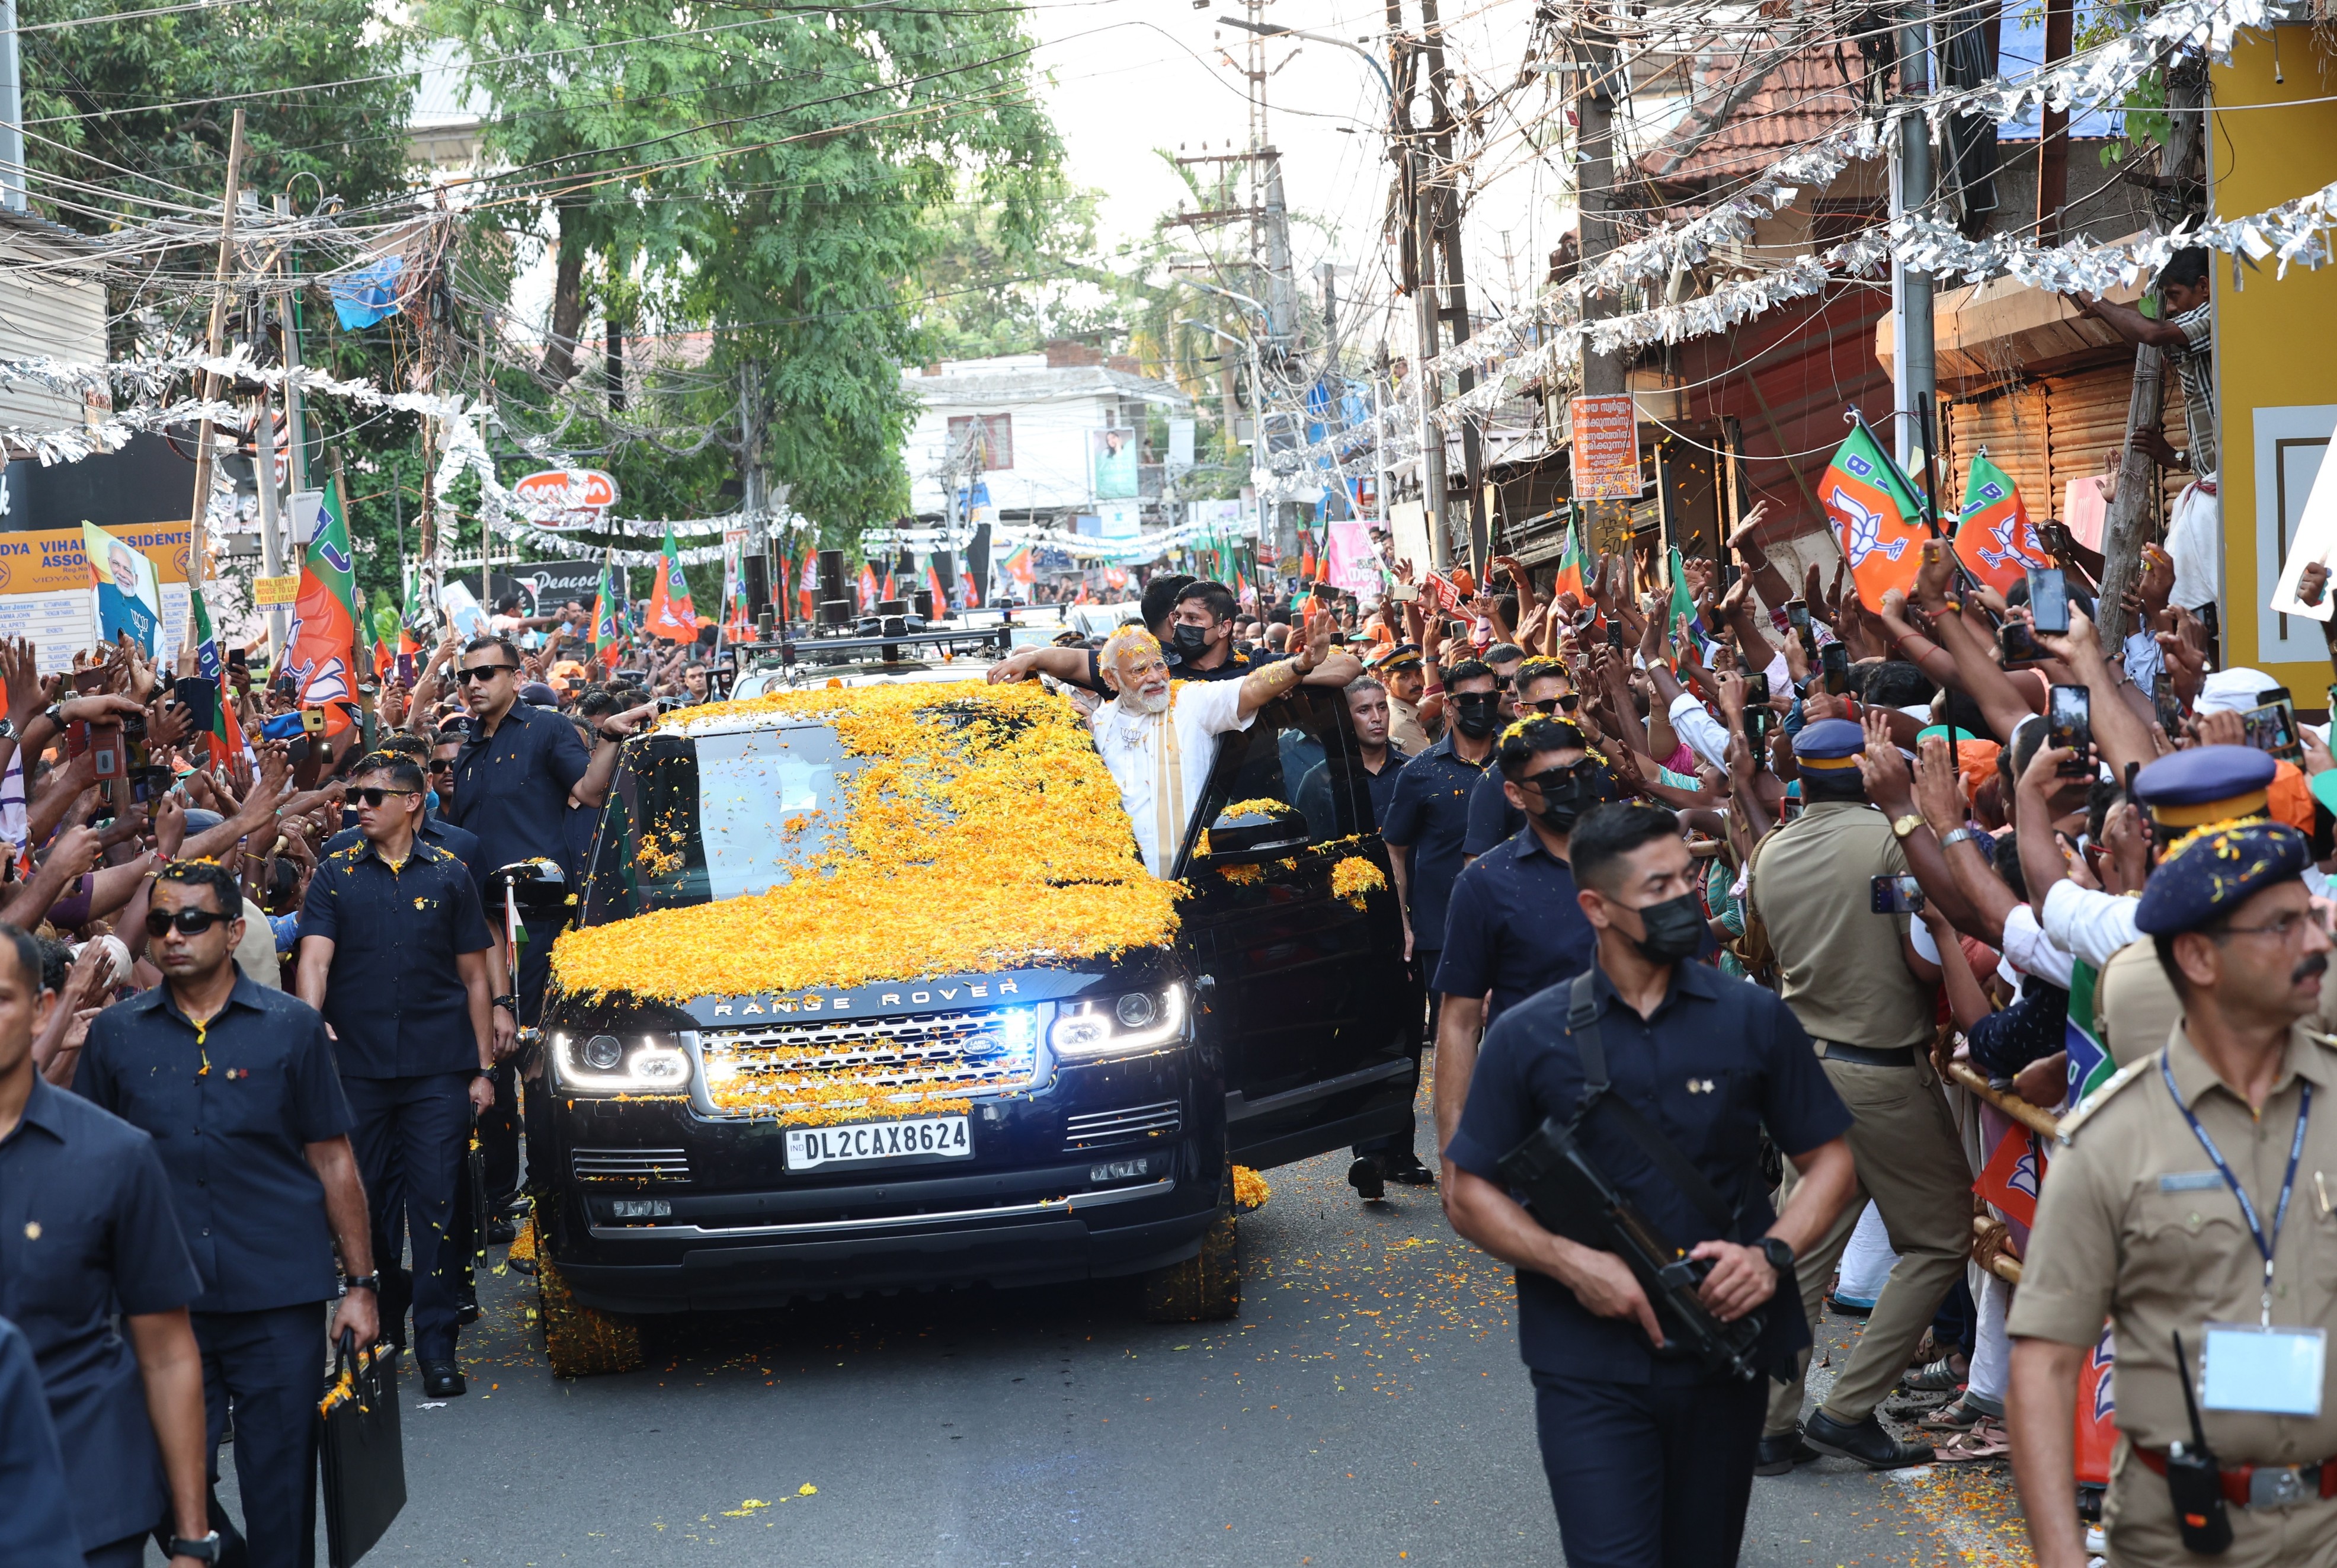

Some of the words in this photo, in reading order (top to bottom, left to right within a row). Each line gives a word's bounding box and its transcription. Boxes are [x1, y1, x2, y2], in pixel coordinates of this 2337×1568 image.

[118, 532, 191, 548] SIDENTS
[274, 578, 295, 587] ESTATE
[714, 997, 850, 1017] RANGE
[882, 982, 1019, 1006] ROVER
[790, 1144, 805, 1152] IND
[805, 1121, 966, 1160] DL2CAX8624
